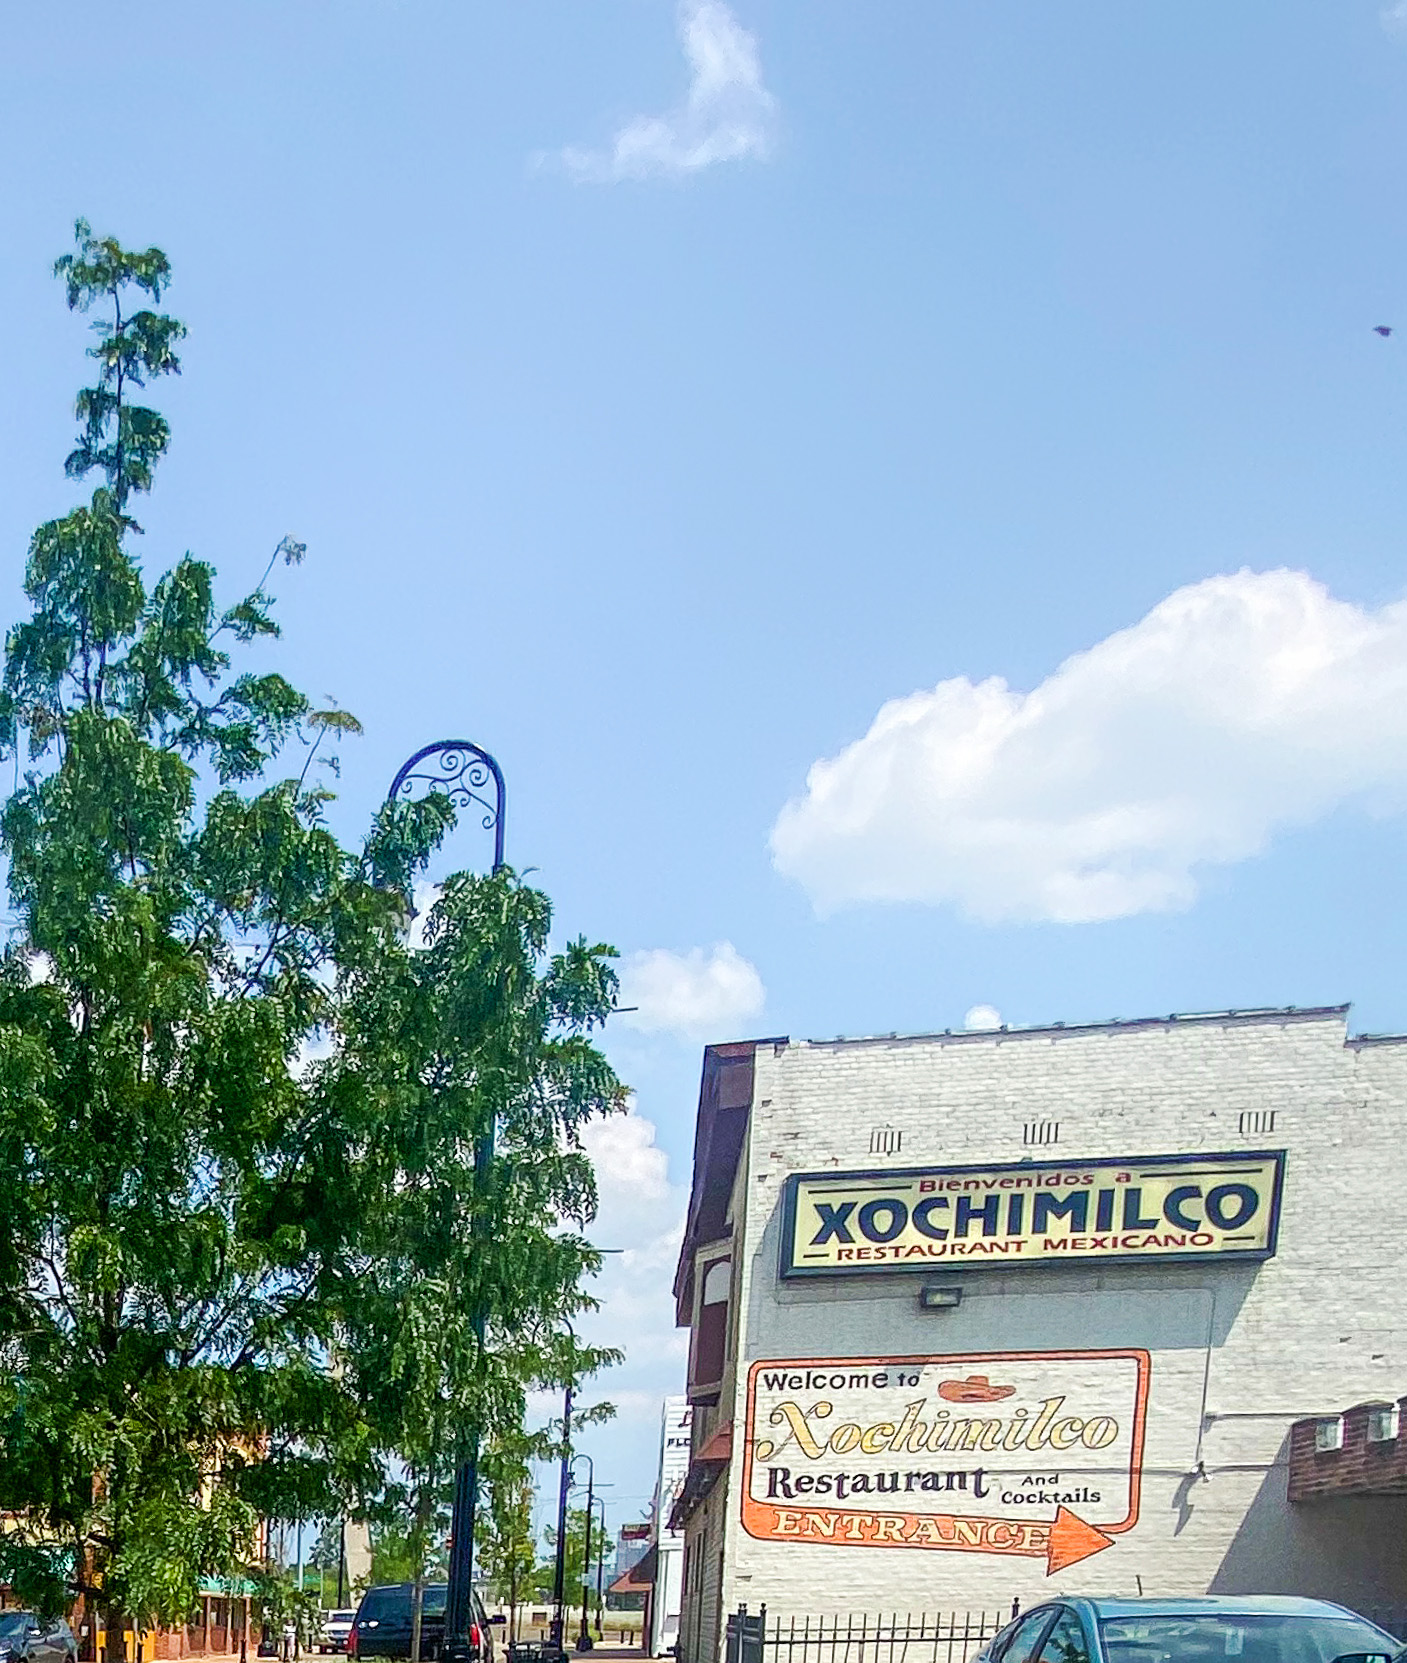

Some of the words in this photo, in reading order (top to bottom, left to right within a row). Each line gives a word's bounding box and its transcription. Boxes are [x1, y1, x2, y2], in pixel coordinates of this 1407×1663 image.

[919, 1173, 1095, 1193] Bienvenidos
[1115, 1172, 1132, 1184] a
[809, 1183, 1260, 1246] XOCHIMILCO
[837, 1240, 1028, 1261] RESTAURANT
[1044, 1233, 1214, 1251] MEXICANO
[764, 1371, 889, 1391] Welcome
[898, 1373, 920, 1387] to
[756, 1396, 1119, 1462] Xochimilco
[766, 1467, 990, 1500] Restaurant
[1022, 1473, 1059, 1486] And
[1001, 1488, 1101, 1504] Cocktails
[772, 1509, 1052, 1550] ENTRANCE
